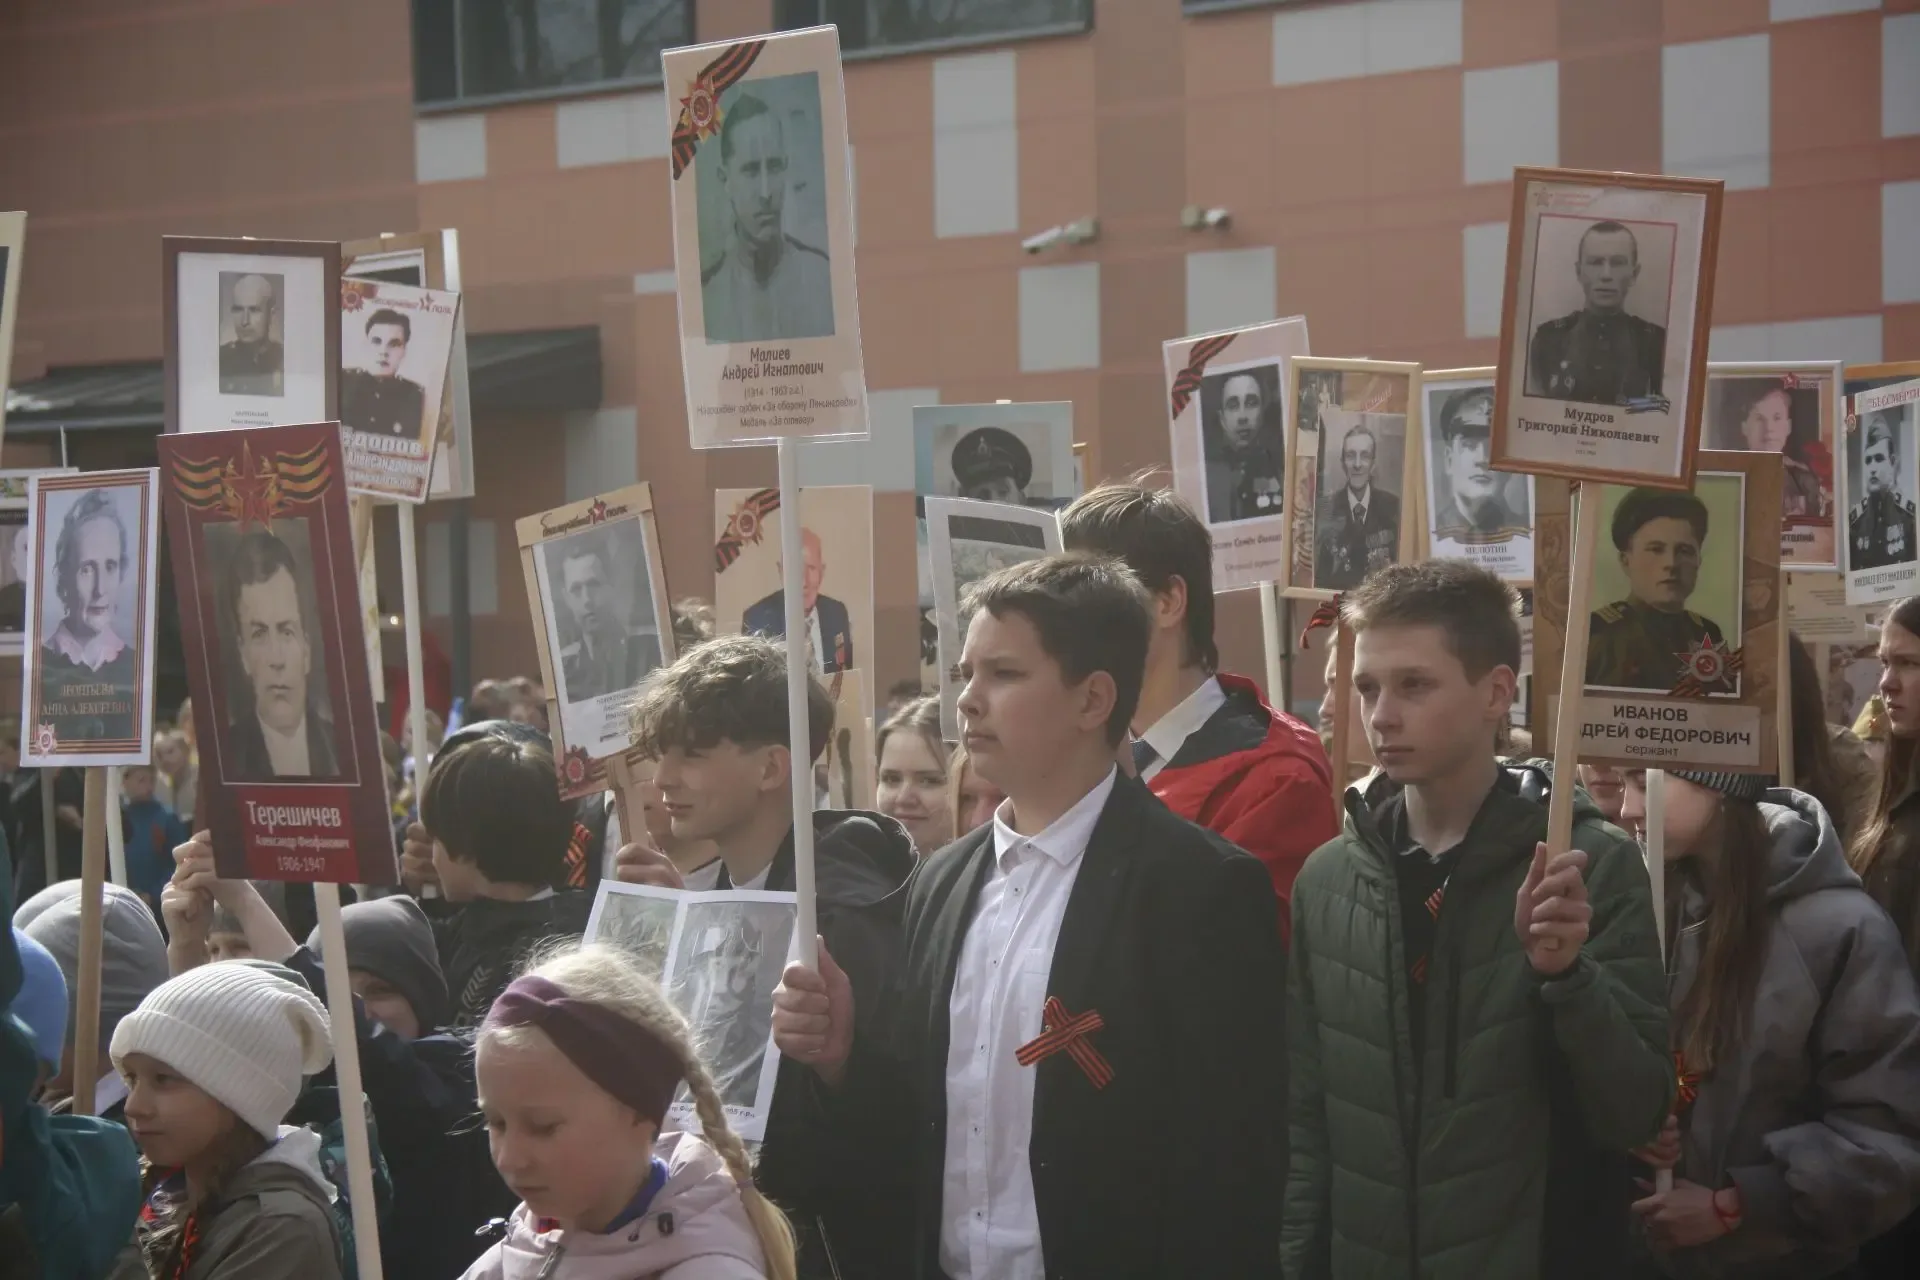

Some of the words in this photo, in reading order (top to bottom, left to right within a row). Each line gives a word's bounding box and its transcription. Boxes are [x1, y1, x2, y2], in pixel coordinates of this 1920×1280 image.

[721, 364, 760, 382] Андрей
[762, 361, 824, 377] Игнатович
[1563, 407, 1615, 425] Мудров
[1517, 417, 1578, 435] Григорий
[1580, 424, 1660, 444] Николаевич
[1613, 704, 1688, 722] ИВАНОВ
[1580, 722, 1629, 740] ДРЕЙ
[1635, 725, 1751, 746] ФЕДОРОВИЧ
[1625, 743, 1679, 757] сержант
[245, 800, 342, 834] Терешичев
